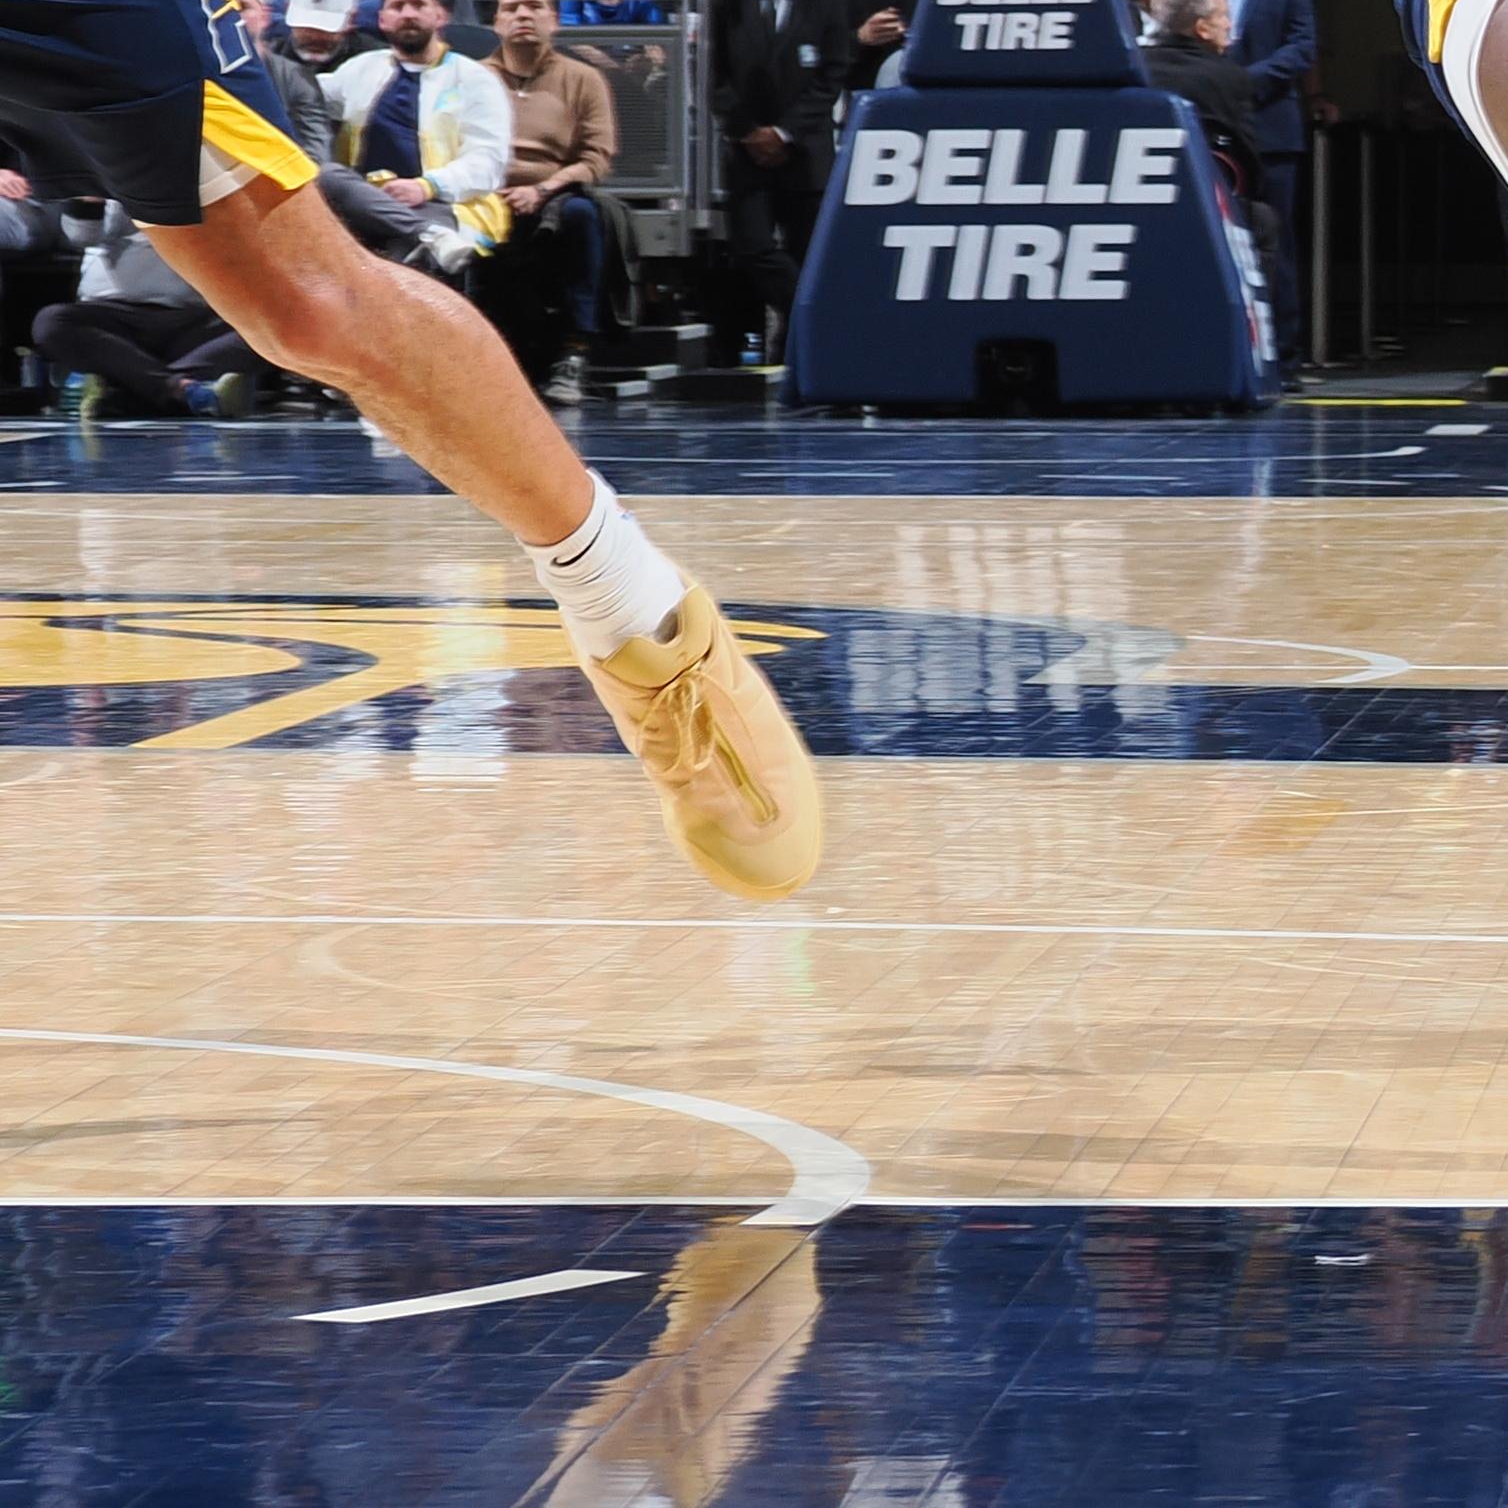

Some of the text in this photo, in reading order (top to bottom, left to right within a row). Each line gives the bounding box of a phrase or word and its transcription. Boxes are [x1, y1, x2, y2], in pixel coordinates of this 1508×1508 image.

[954, 11, 1077, 51] TIRE
[844, 128, 1188, 206] BELLE
[883, 223, 1138, 301] TIRE
